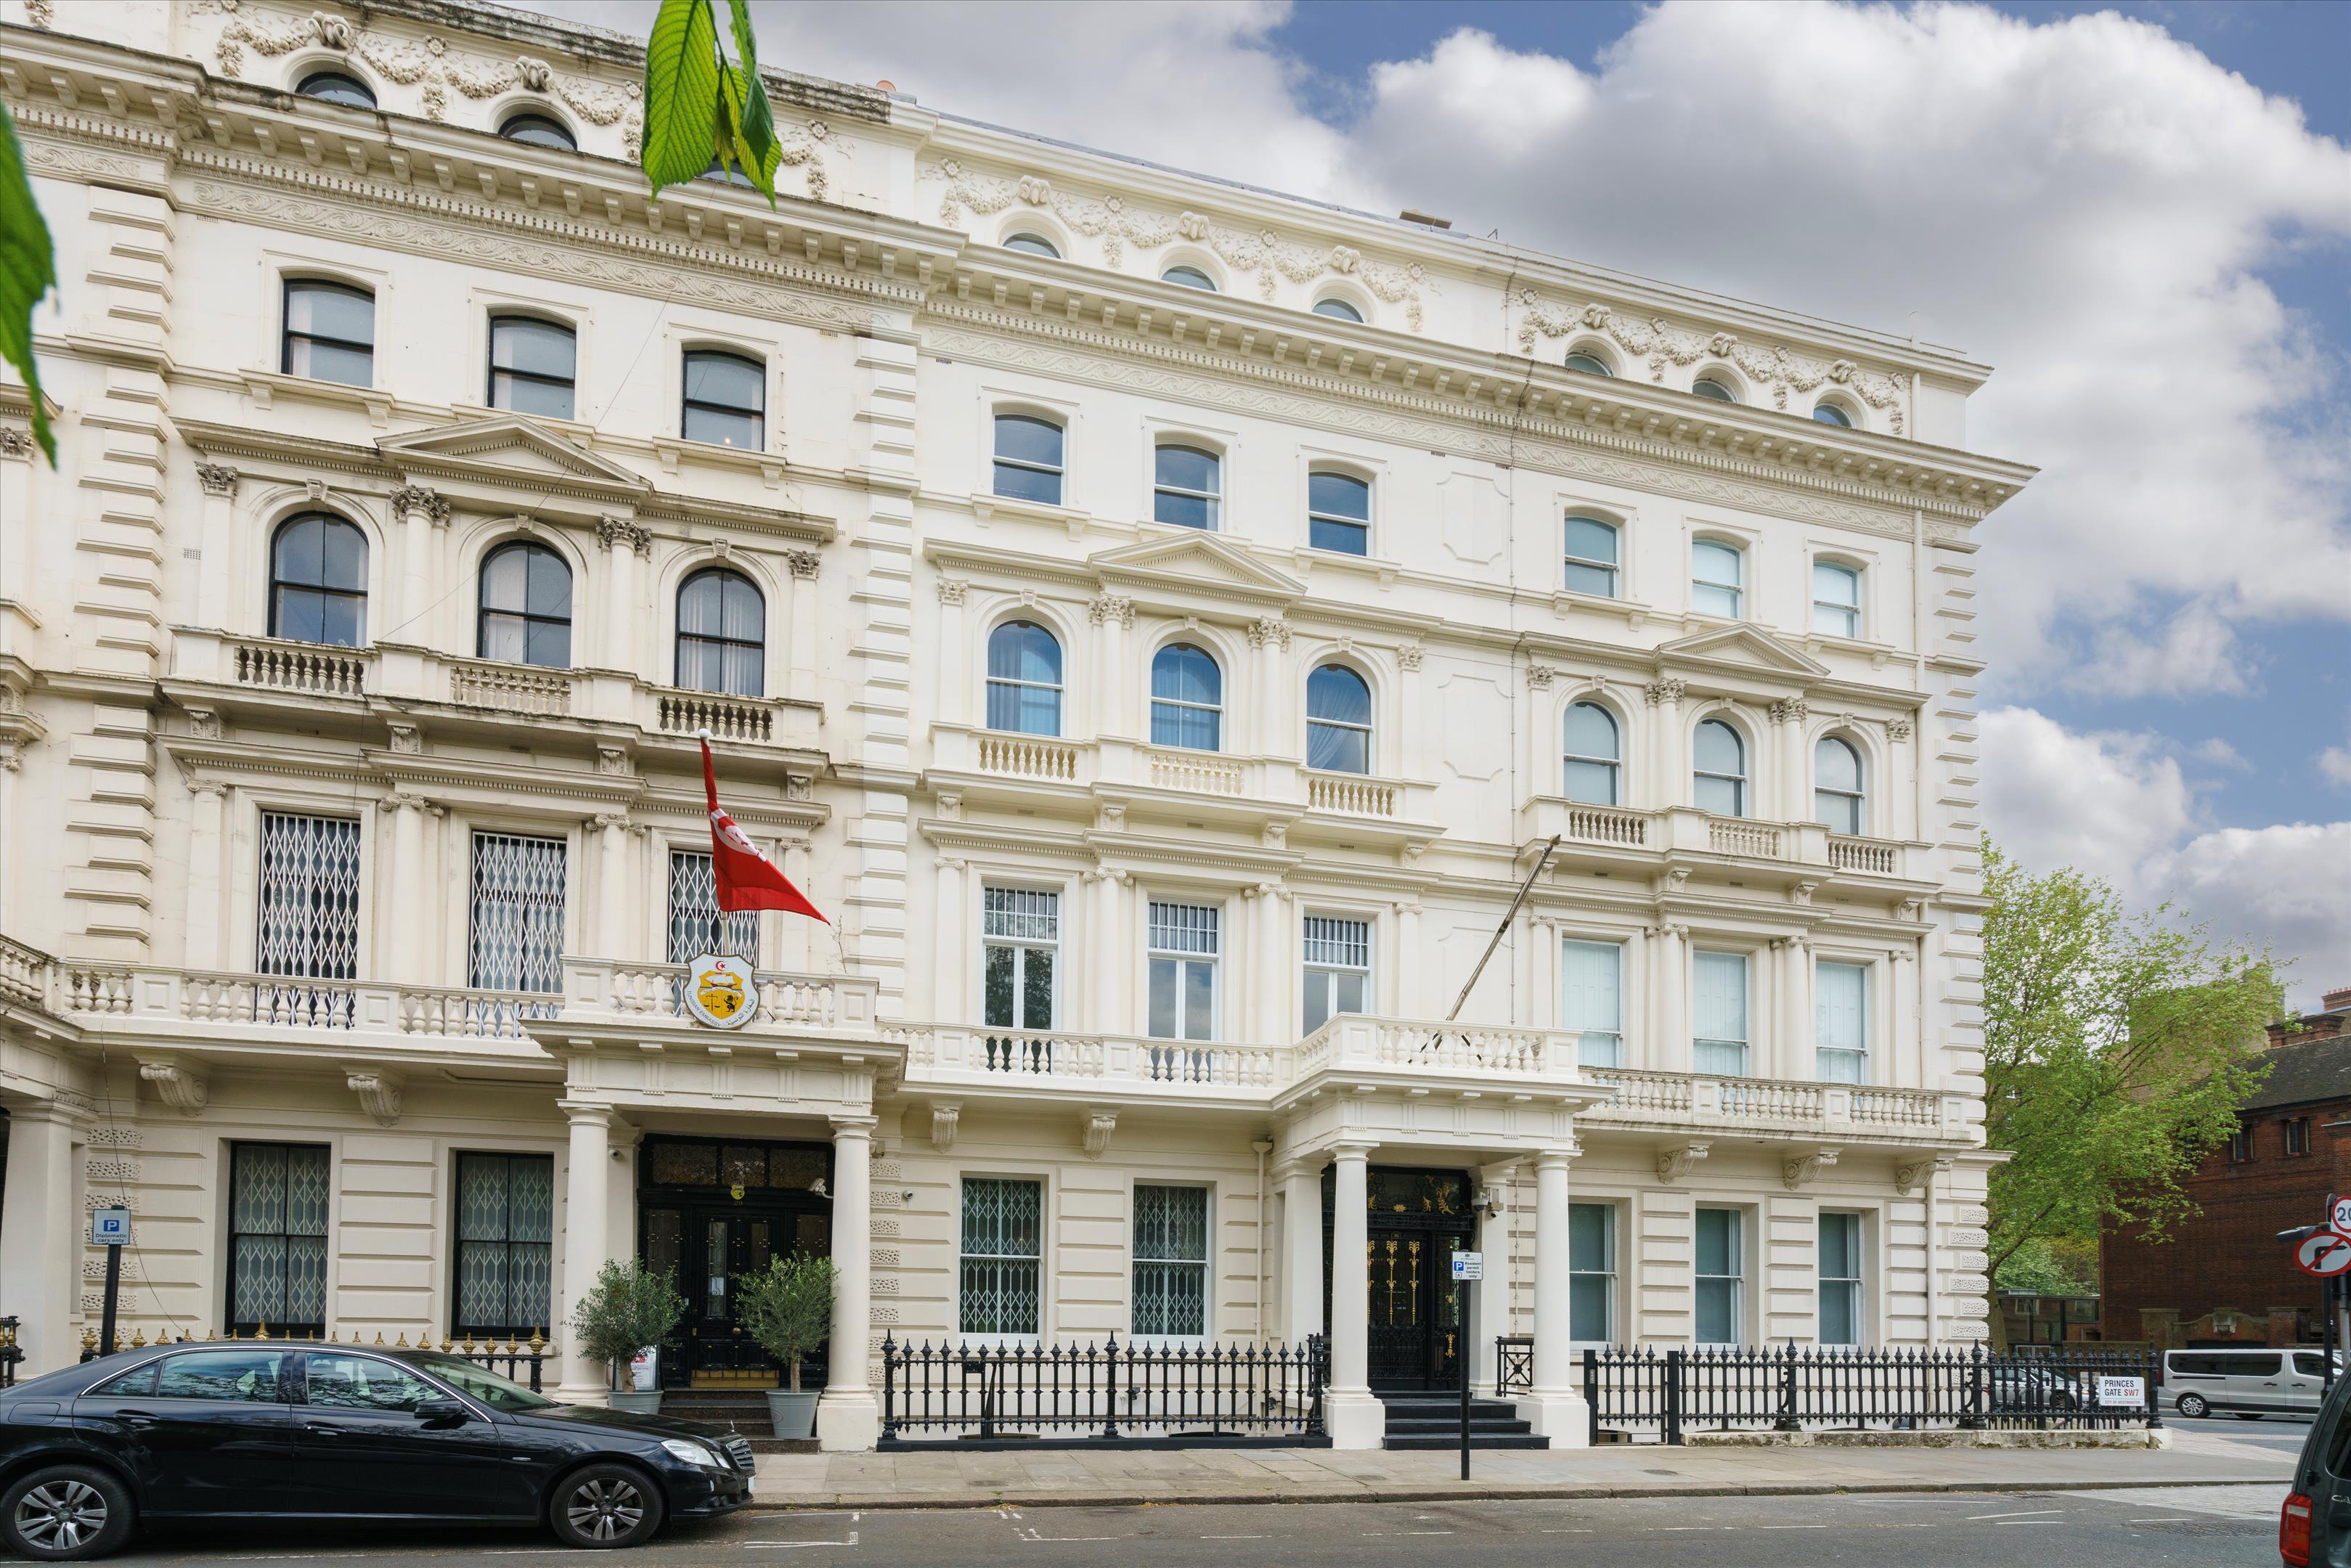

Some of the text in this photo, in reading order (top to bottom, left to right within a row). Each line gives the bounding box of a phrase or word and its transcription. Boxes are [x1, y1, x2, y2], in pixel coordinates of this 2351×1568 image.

[687, 990, 700, 1010] TUNISIAN
[698, 1010, 721, 1026] EMBASSY
[107, 1221, 118, 1231] P
[1456, 1262, 1463, 1270] P
